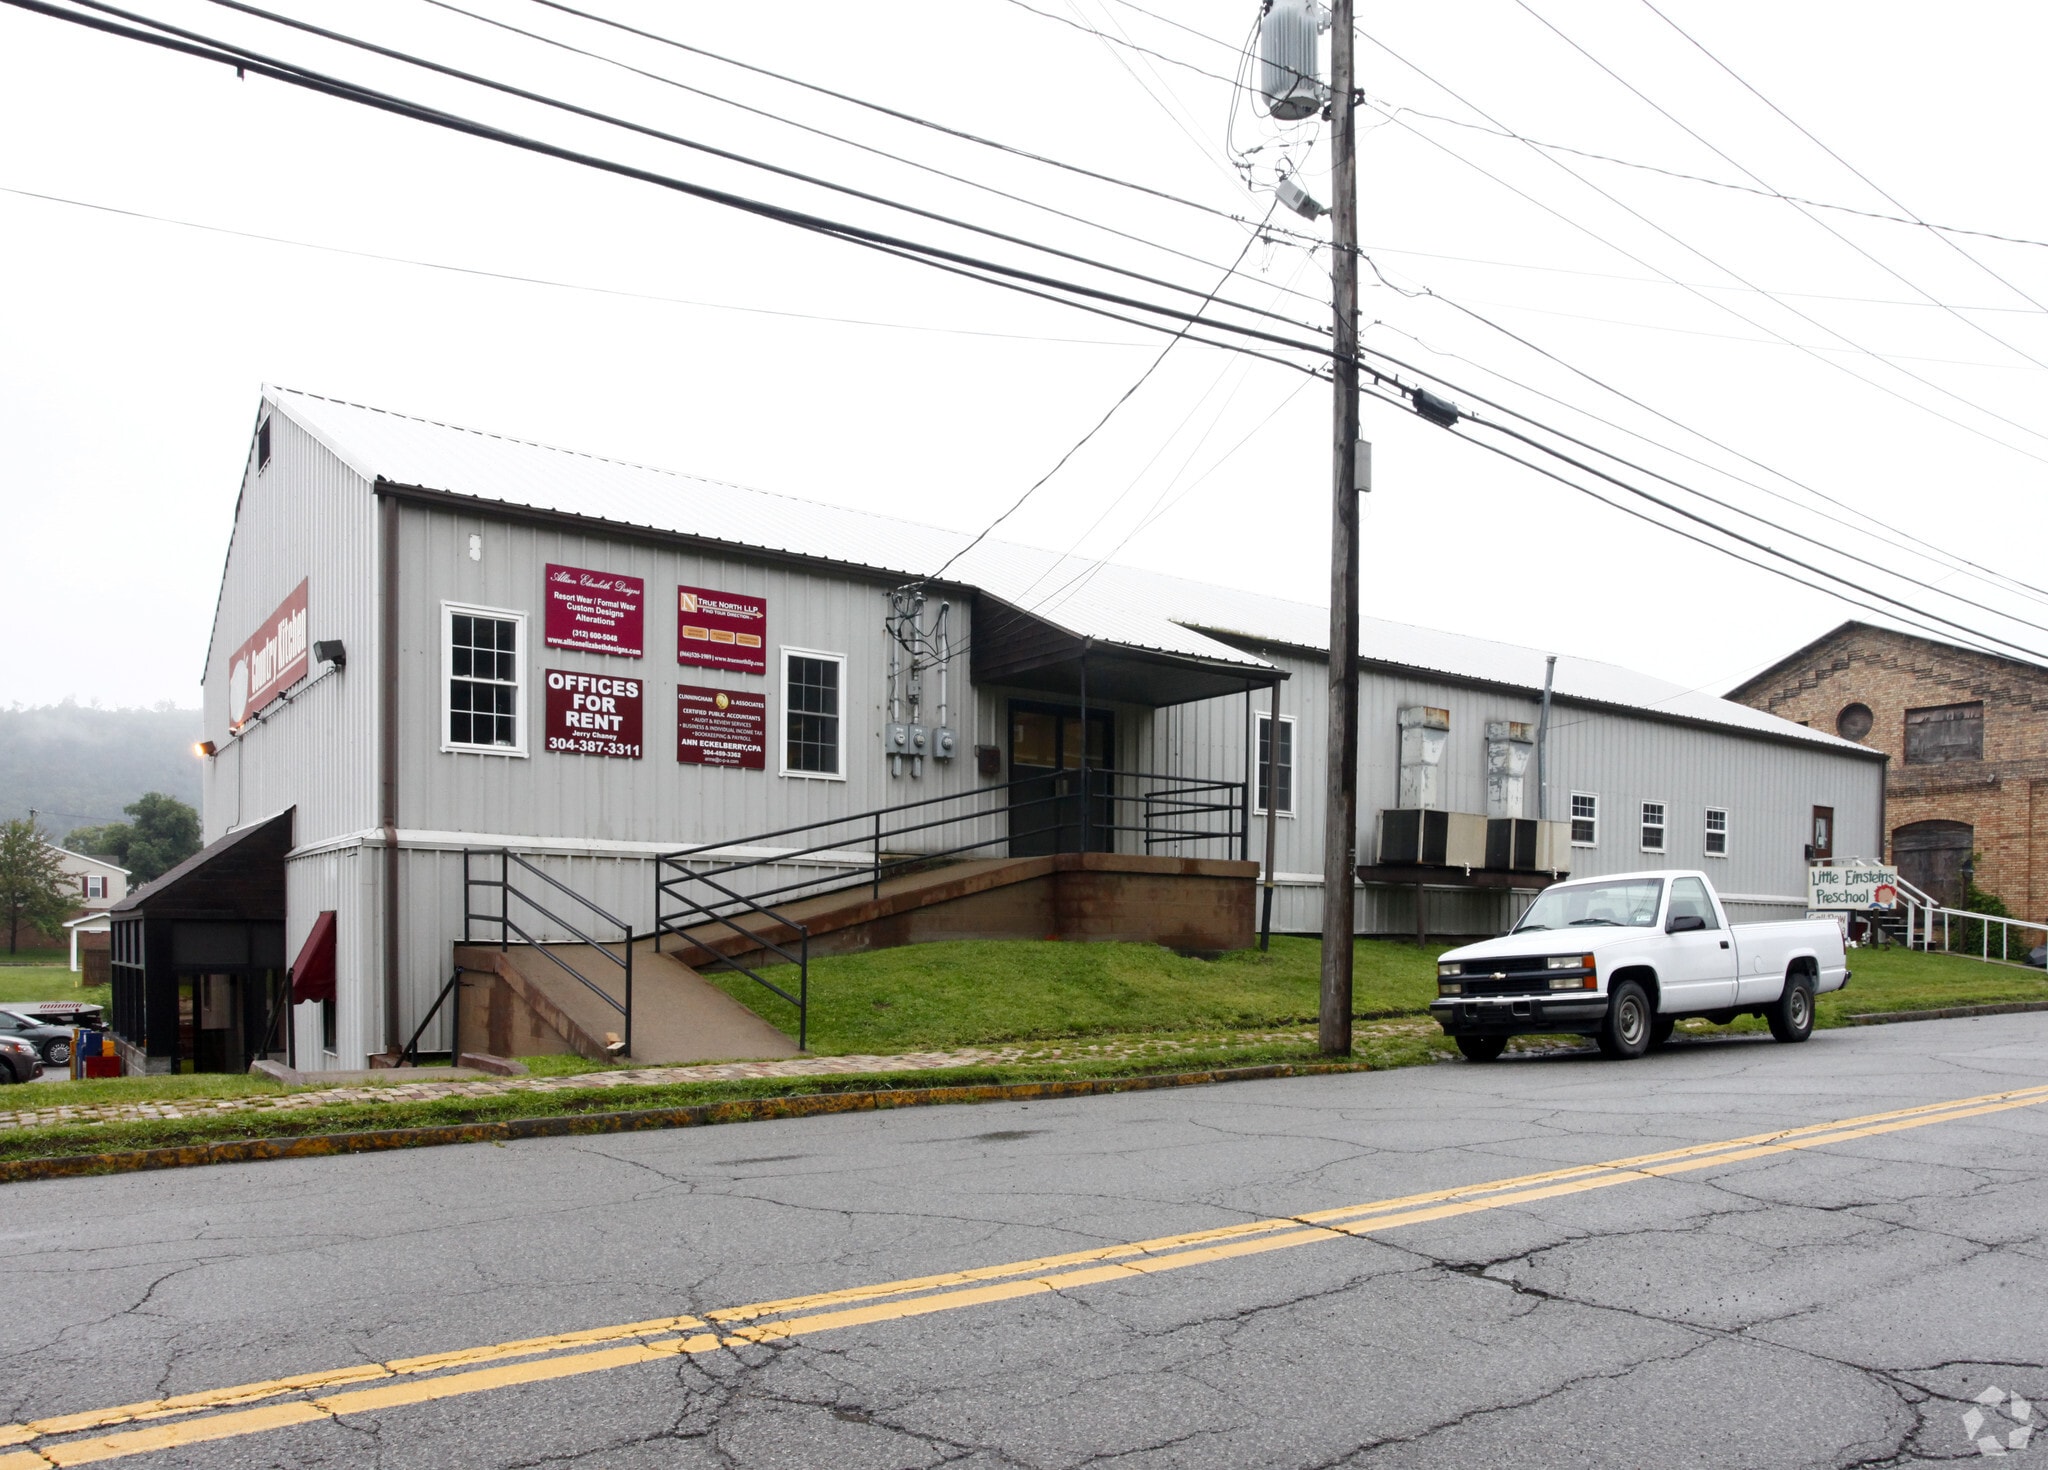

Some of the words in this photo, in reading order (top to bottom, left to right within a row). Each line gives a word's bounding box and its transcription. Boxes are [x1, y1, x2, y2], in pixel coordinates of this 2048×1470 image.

[550, 571, 576, 584] Allison
[580, 574, 613, 590] Elizabeth
[615, 580, 640, 596] Designs
[554, 591, 575, 601] Resort
[576, 595, 592, 604] Wear
[598, 598, 619, 608] Formal
[620, 602, 636, 611] Wear
[698, 598, 718, 607] TRUE
[719, 601, 742, 611] NORTH
[567, 602, 594, 613] Custom
[596, 607, 624, 618] Designs
[576, 614, 615, 626] Alterations
[278, 607, 306, 670] Kitchen
[572, 629, 588, 639] (312)
[548, 637, 641, 655] www.allisonelizabethdesigns.com
[548, 673, 638, 698] OFFICES
[573, 694, 616, 713] FOR
[678, 694, 713, 702] CUNNINGHAM
[736, 700, 764, 708] ASSOCIATES
[566, 711, 623, 731] RENT
[726, 713, 760, 721] ACCOUNTANTS
[572, 730, 591, 738] Jerry
[592, 732, 617, 741] Chaney
[549, 737, 640, 756] 304-387-3311
[1812, 870, 1838, 886] Little
[1845, 870, 1894, 885] Einsteins
[1816, 889, 1869, 905] Preschool
